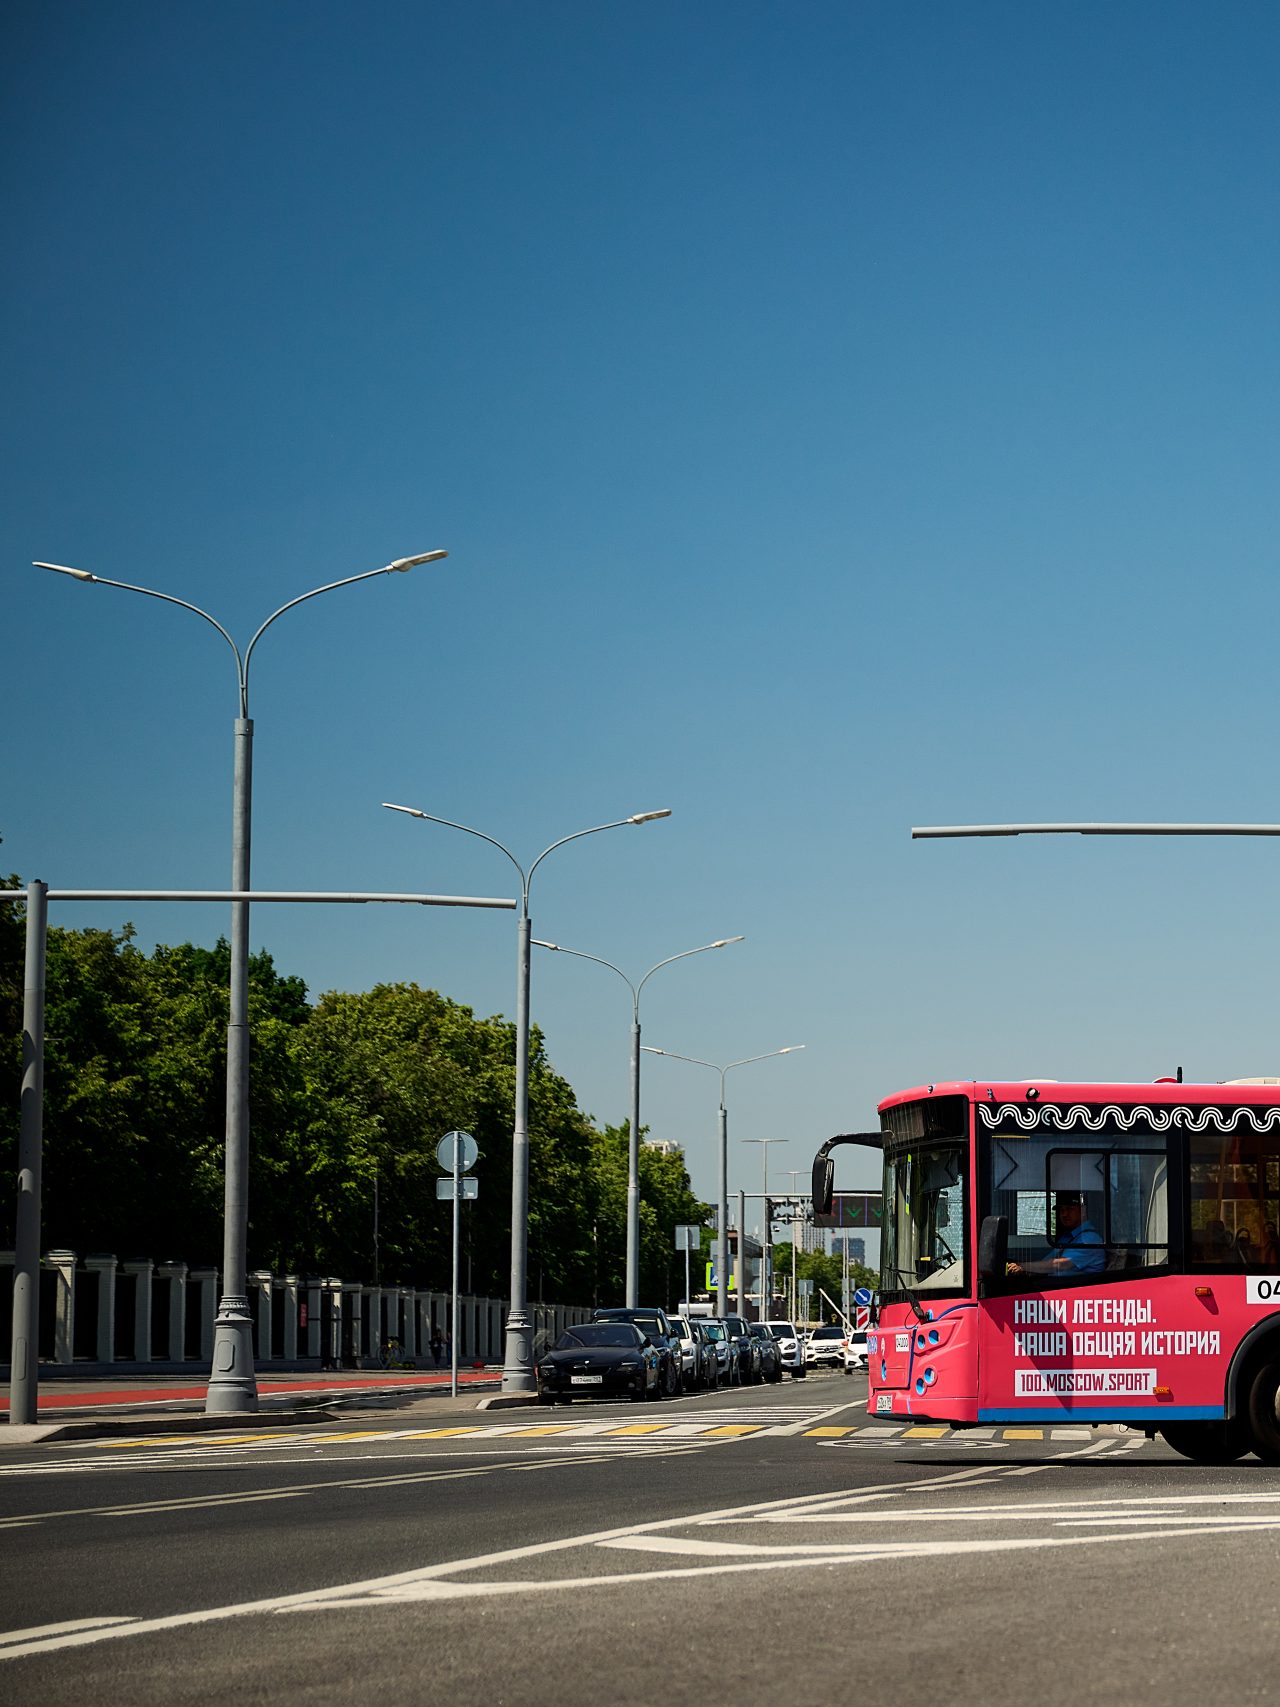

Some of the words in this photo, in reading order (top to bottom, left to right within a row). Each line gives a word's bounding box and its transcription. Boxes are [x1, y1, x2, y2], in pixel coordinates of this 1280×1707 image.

[1014, 1300, 1066, 1324] НАШИ
[1072, 1299, 1157, 1327] ЛЕГЕНДЫ.
[1014, 1332, 1066, 1357] НАША
[1073, 1332, 1136, 1359] ОБЩАЯ
[1141, 1331, 1220, 1356] ИСТОРИЯ
[1020, 1374, 1150, 1392] 100.MOSCOW.SPORT
